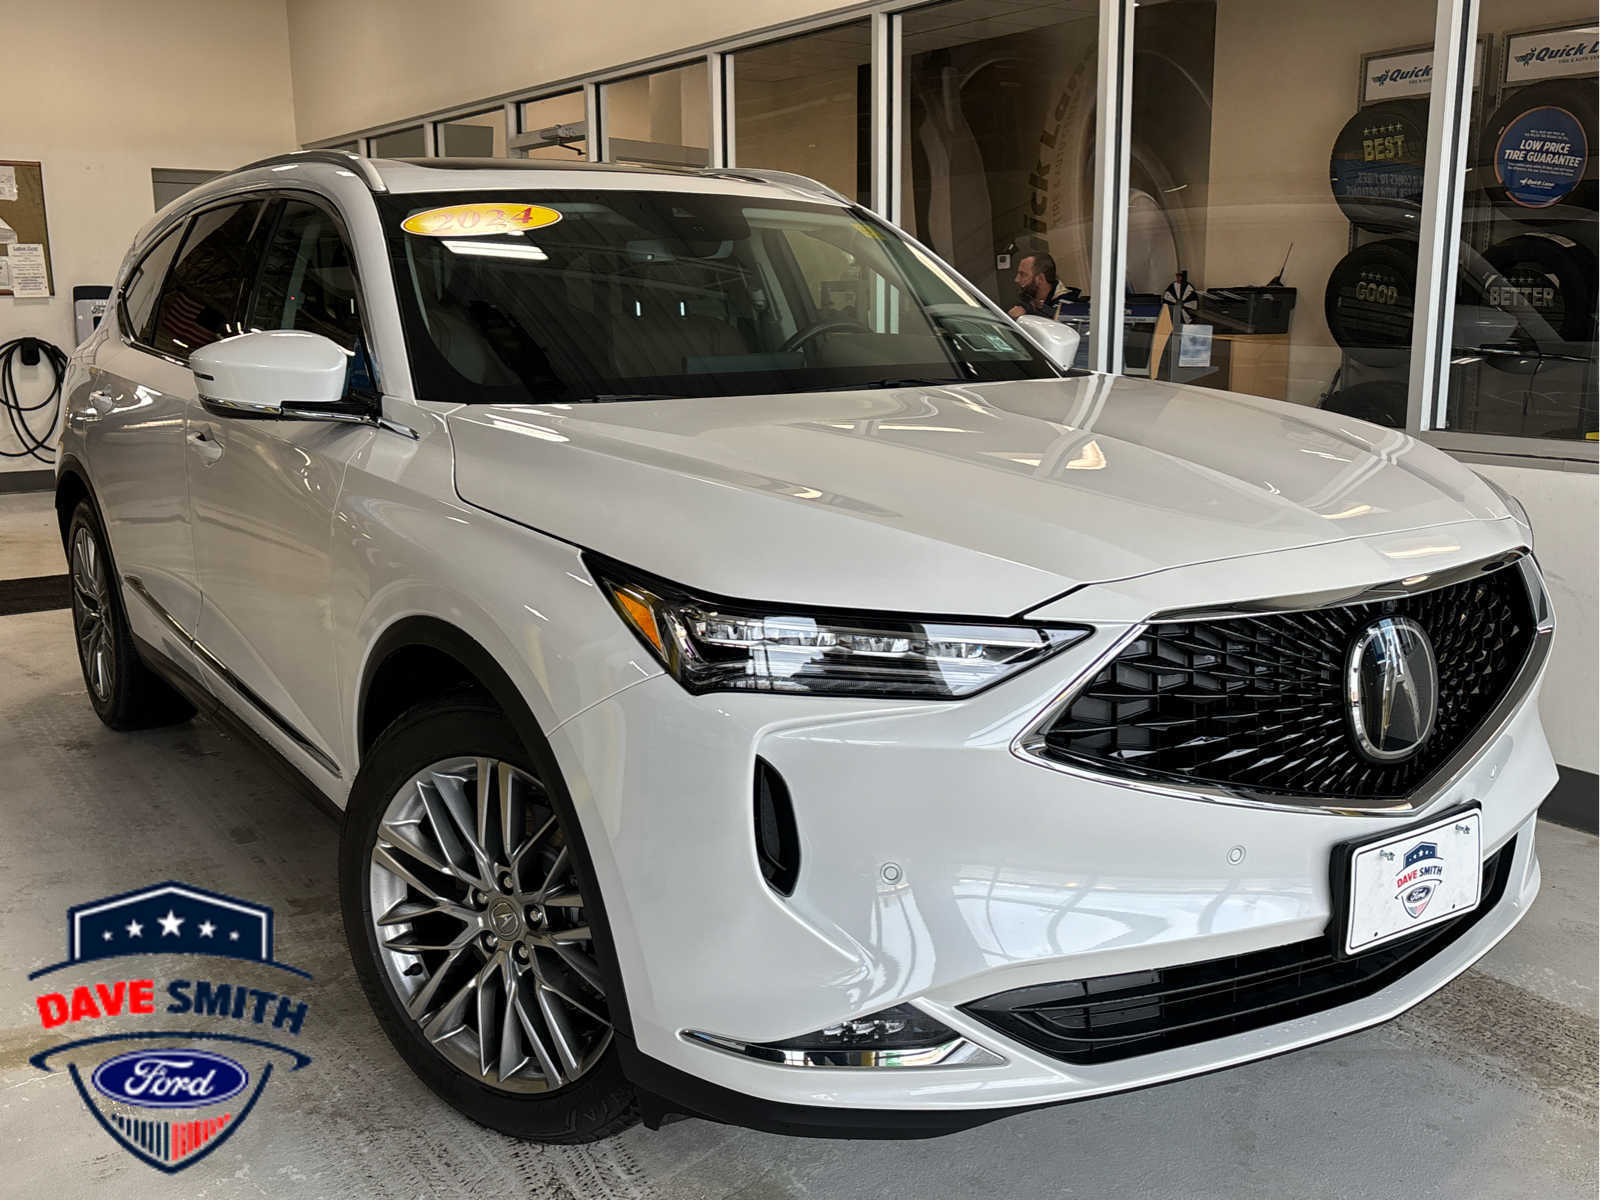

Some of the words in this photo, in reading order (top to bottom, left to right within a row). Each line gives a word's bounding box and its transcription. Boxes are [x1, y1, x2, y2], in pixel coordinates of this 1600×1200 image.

[1535, 42, 1590, 62] Quick
[1389, 64, 1433, 82] Quick
[1362, 135, 1405, 161] BEST
[1519, 139, 1544, 151] LOW
[1543, 142, 1572, 154] PRICE
[1504, 149, 1527, 161] TIRE
[1526, 151, 1583, 167] GUARANTEE
[432, 207, 534, 233] 2024
[1356, 281, 1398, 305] GOOD
[1489, 286, 1556, 306] BETTER
[1397, 869, 1418, 888] DAVE
[1419, 865, 1443, 877] SMITH
